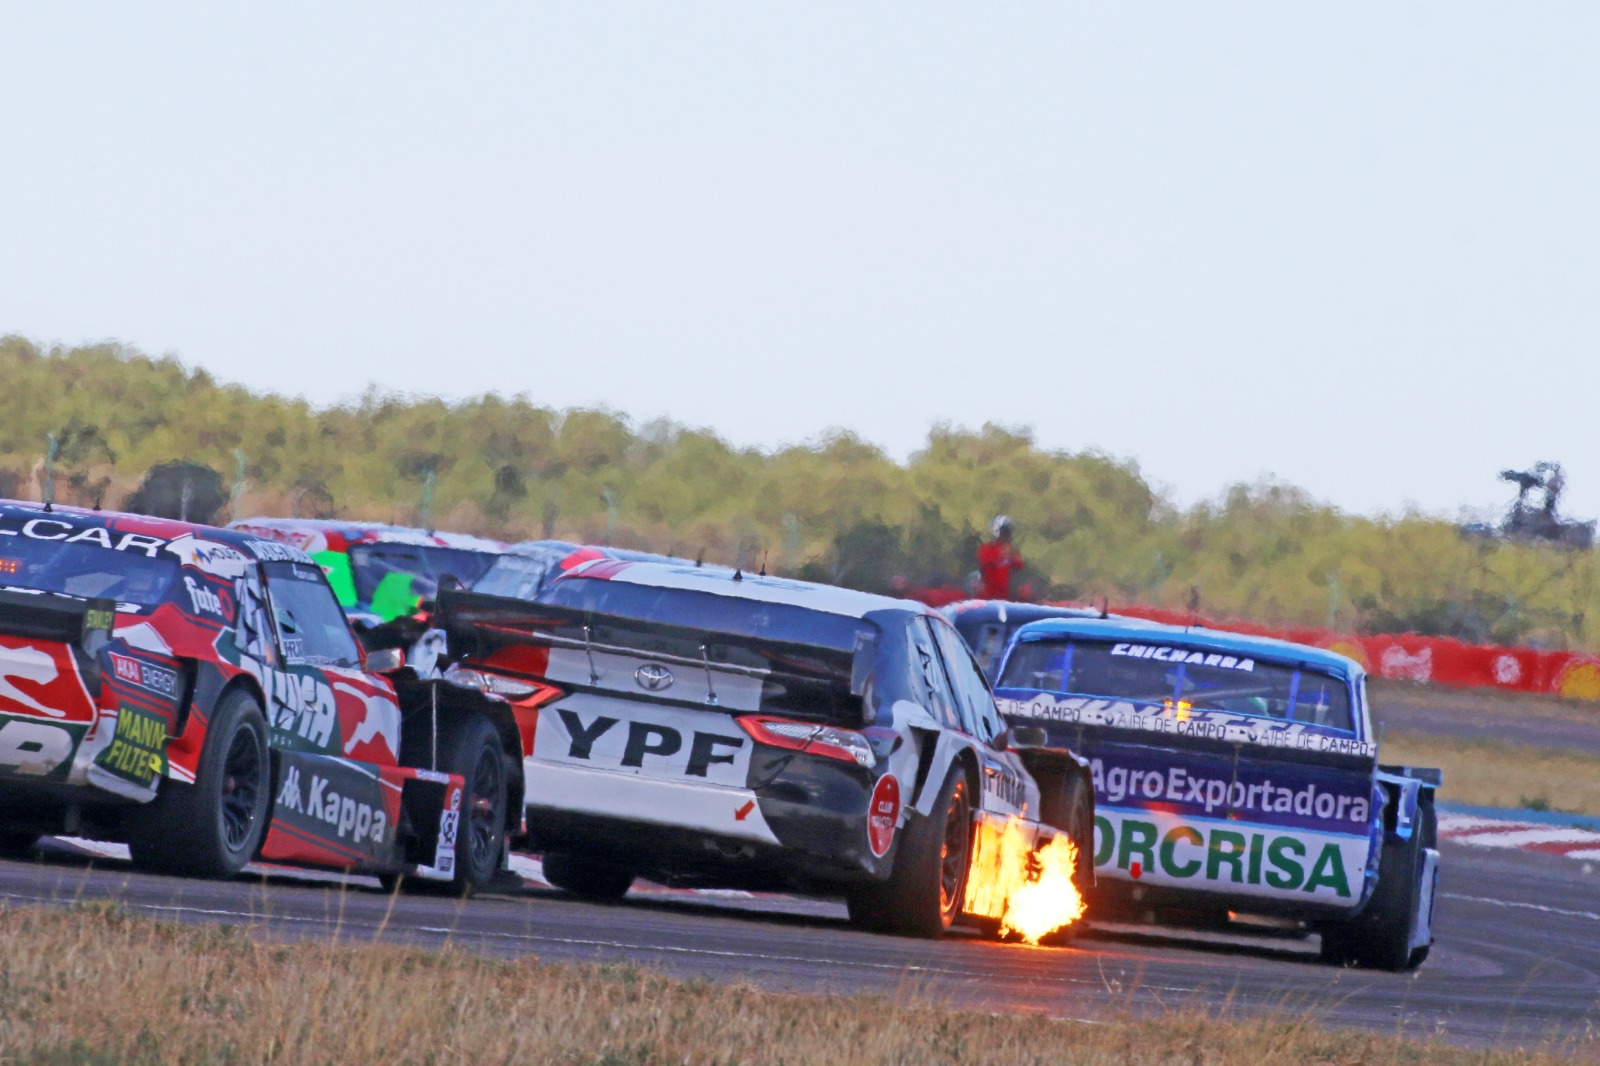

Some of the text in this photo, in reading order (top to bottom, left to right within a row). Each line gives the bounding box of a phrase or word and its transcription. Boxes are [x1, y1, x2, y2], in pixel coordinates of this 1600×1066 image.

[117, 658, 177, 693] AKAI ENERGY
[117, 708, 166, 750] MANN
[556, 708, 745, 778] YPF
[1031, 702, 1081, 722] CAMPO
[1177, 721, 1227, 739] CAMPO
[1320, 736, 1368, 756] CAMPO
[105, 740, 162, 782] FILTER
[307, 774, 387, 843] Kappa
[1089, 758, 1370, 823] AgroExportadora
